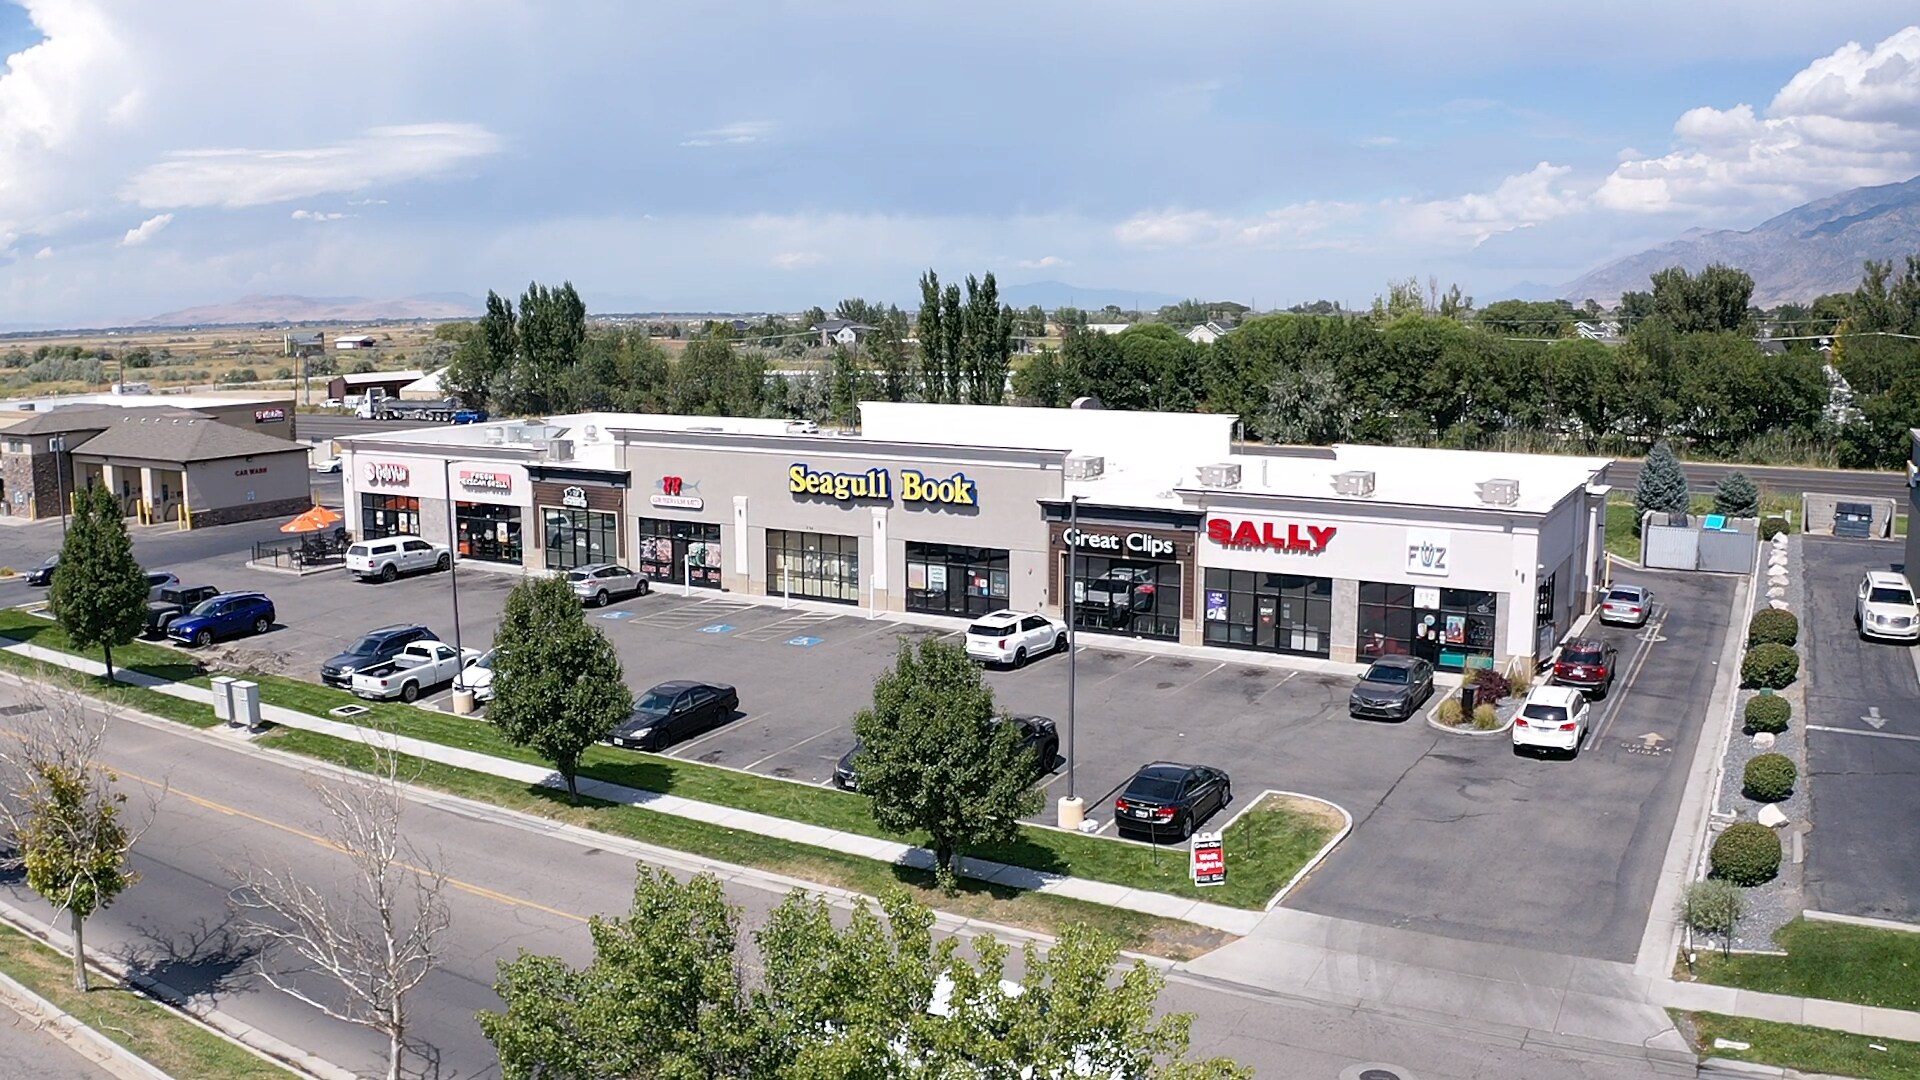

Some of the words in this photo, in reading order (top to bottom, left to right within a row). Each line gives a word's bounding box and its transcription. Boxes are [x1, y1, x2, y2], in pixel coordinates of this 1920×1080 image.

[249, 467, 267, 475] WASH
[789, 463, 891, 500] Seagull
[901, 469, 976, 506] Book
[1063, 527, 1120, 550] Great
[1125, 532, 1174, 558] Clips
[1207, 518, 1337, 550] SALLY
